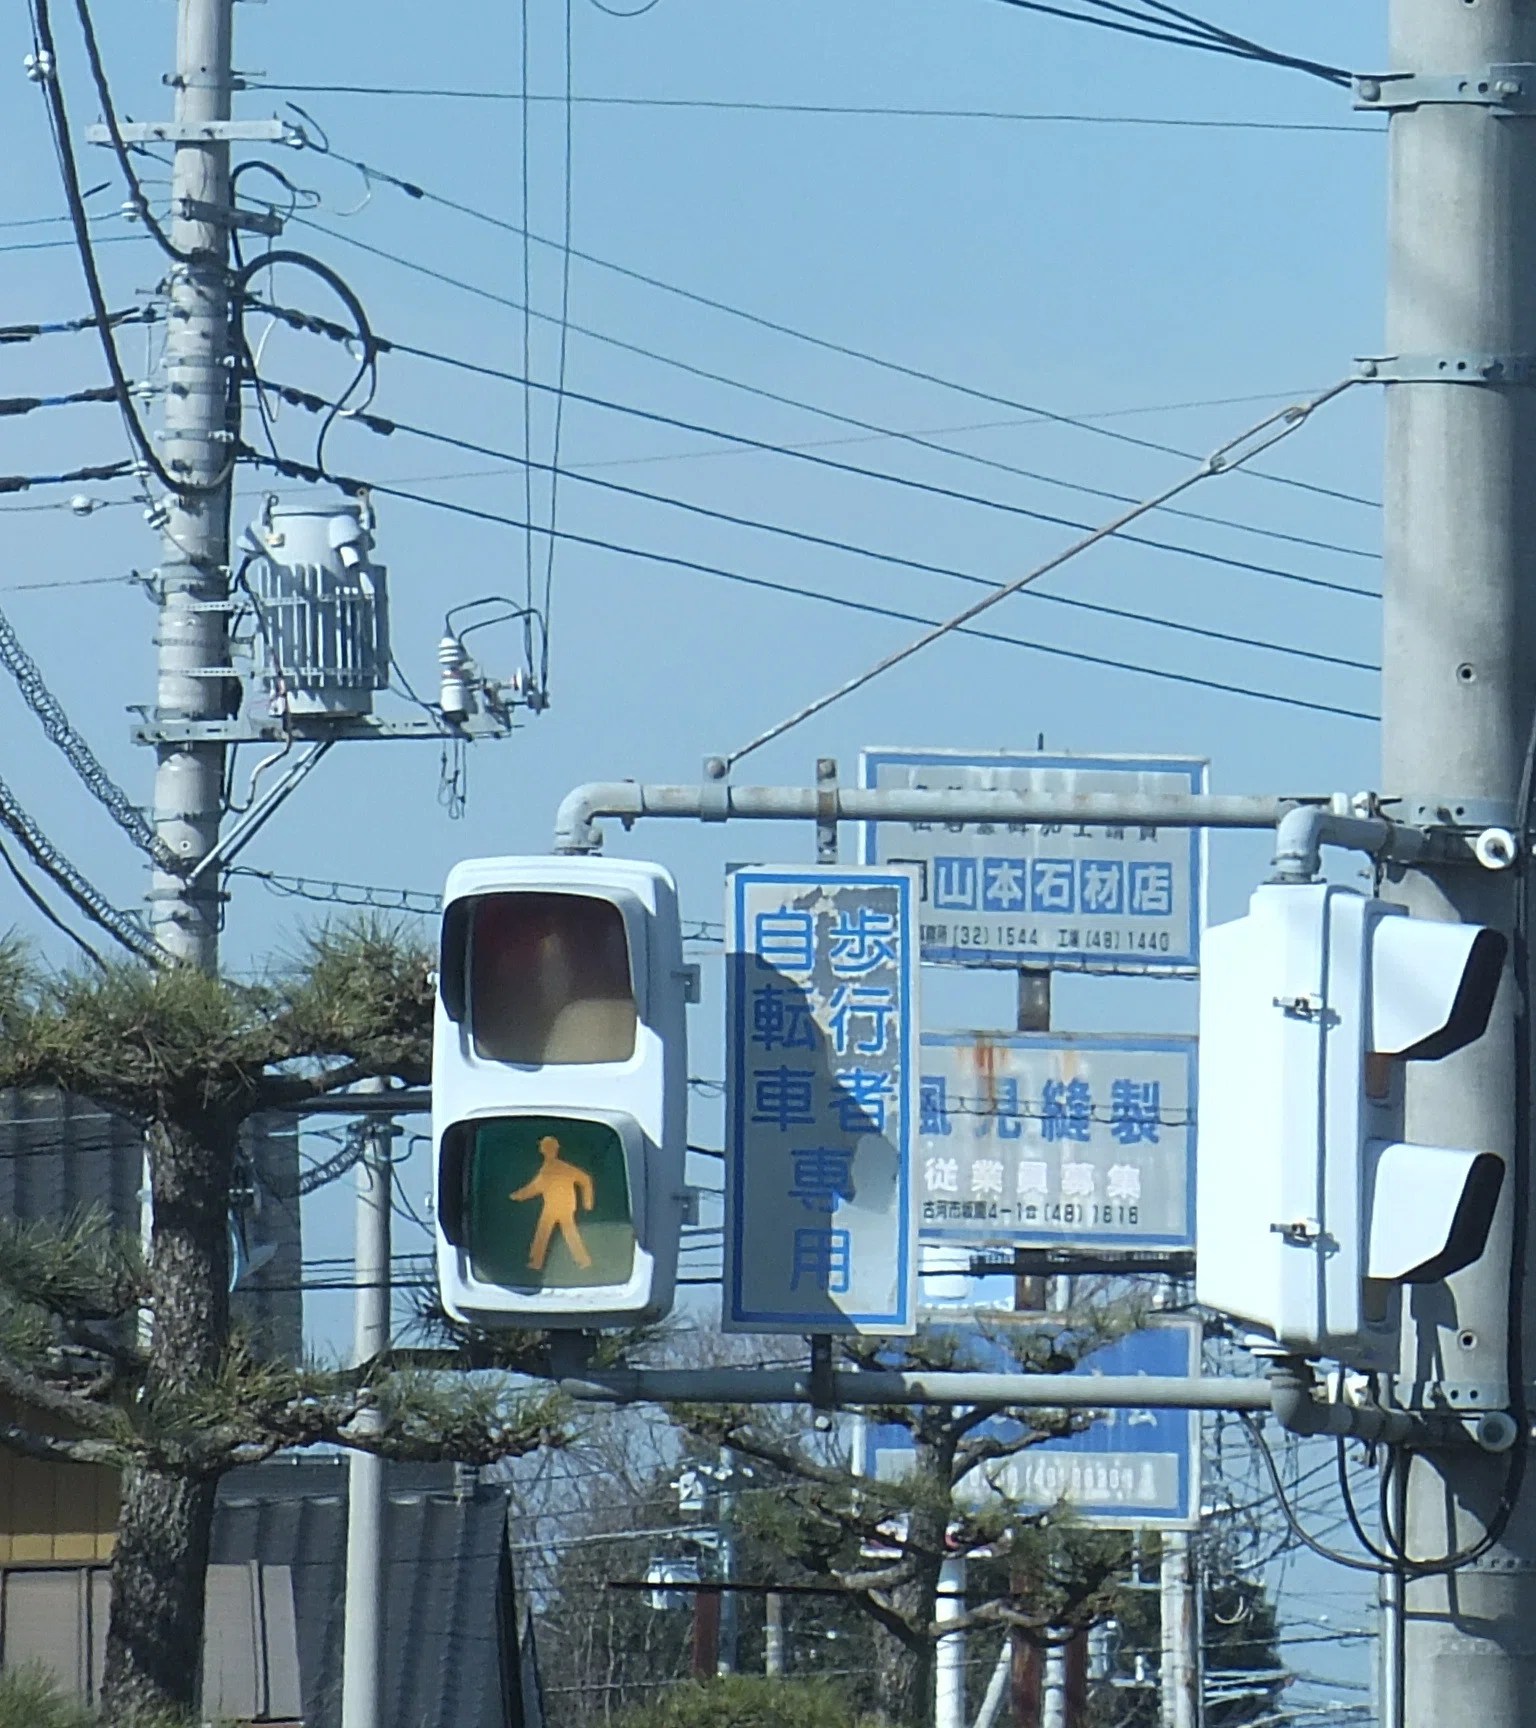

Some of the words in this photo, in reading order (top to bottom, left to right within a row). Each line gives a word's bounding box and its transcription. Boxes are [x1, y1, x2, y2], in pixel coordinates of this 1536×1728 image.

[937, 860, 1169, 912] 山本石材店
[750, 905, 818, 1132] 自転車
[828, 908, 896, 1133] 歩行者
[787, 1146, 857, 1294] 専用
